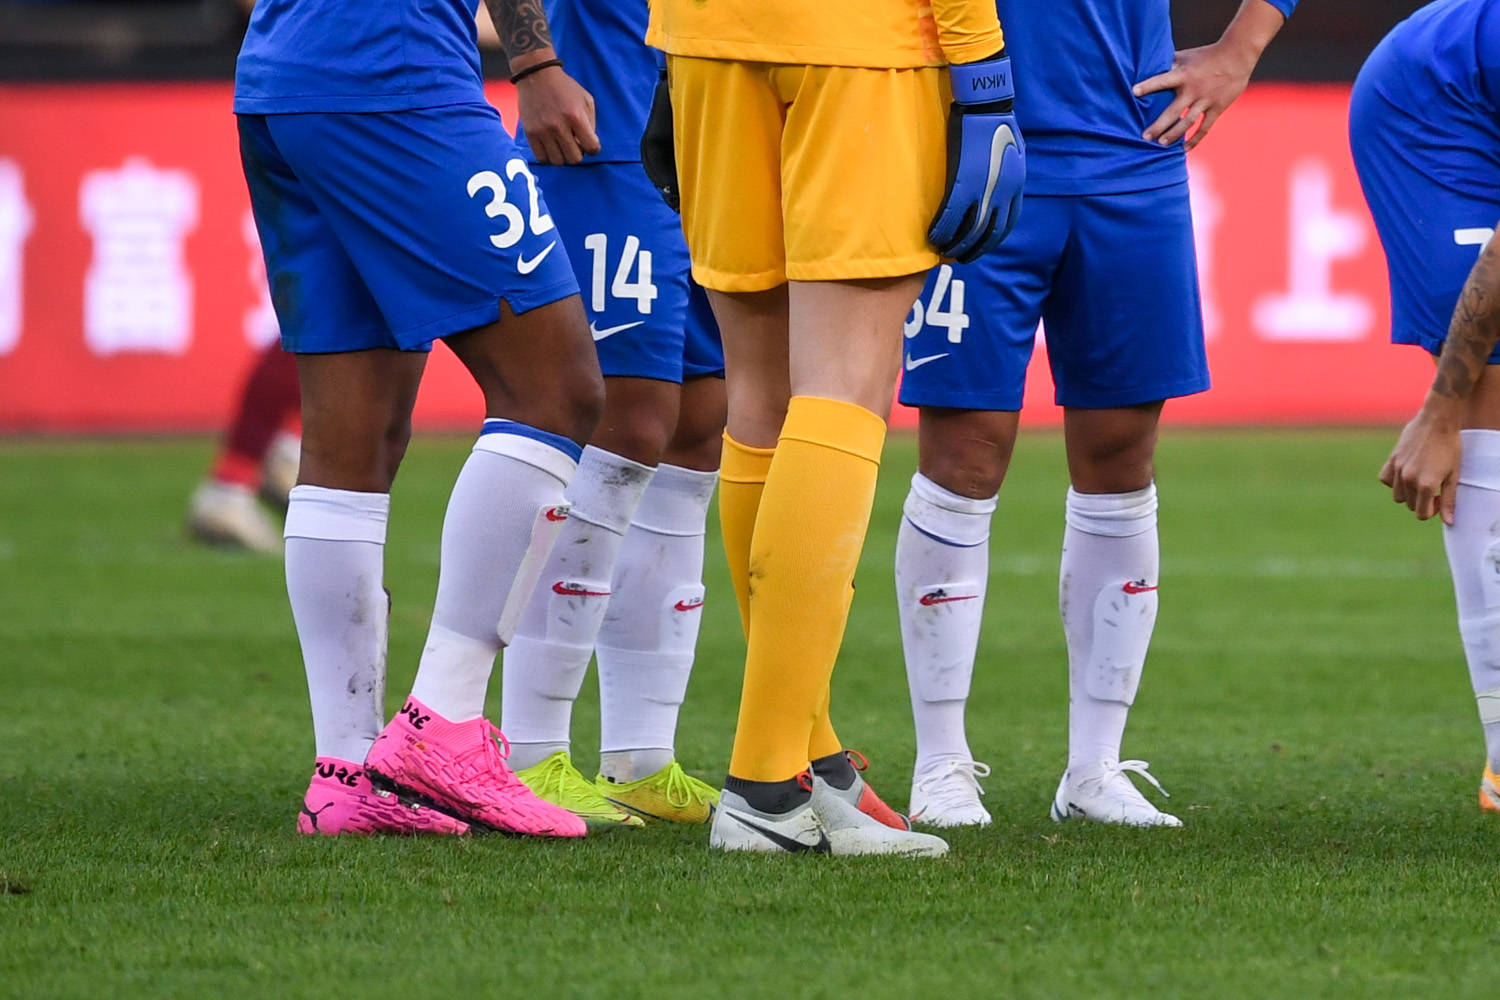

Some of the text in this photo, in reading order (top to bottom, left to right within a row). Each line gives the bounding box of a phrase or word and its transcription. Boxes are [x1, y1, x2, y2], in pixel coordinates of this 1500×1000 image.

[972, 73, 1007, 92] MKM
[467, 158, 555, 249] 32
[584, 232, 658, 314] 14
